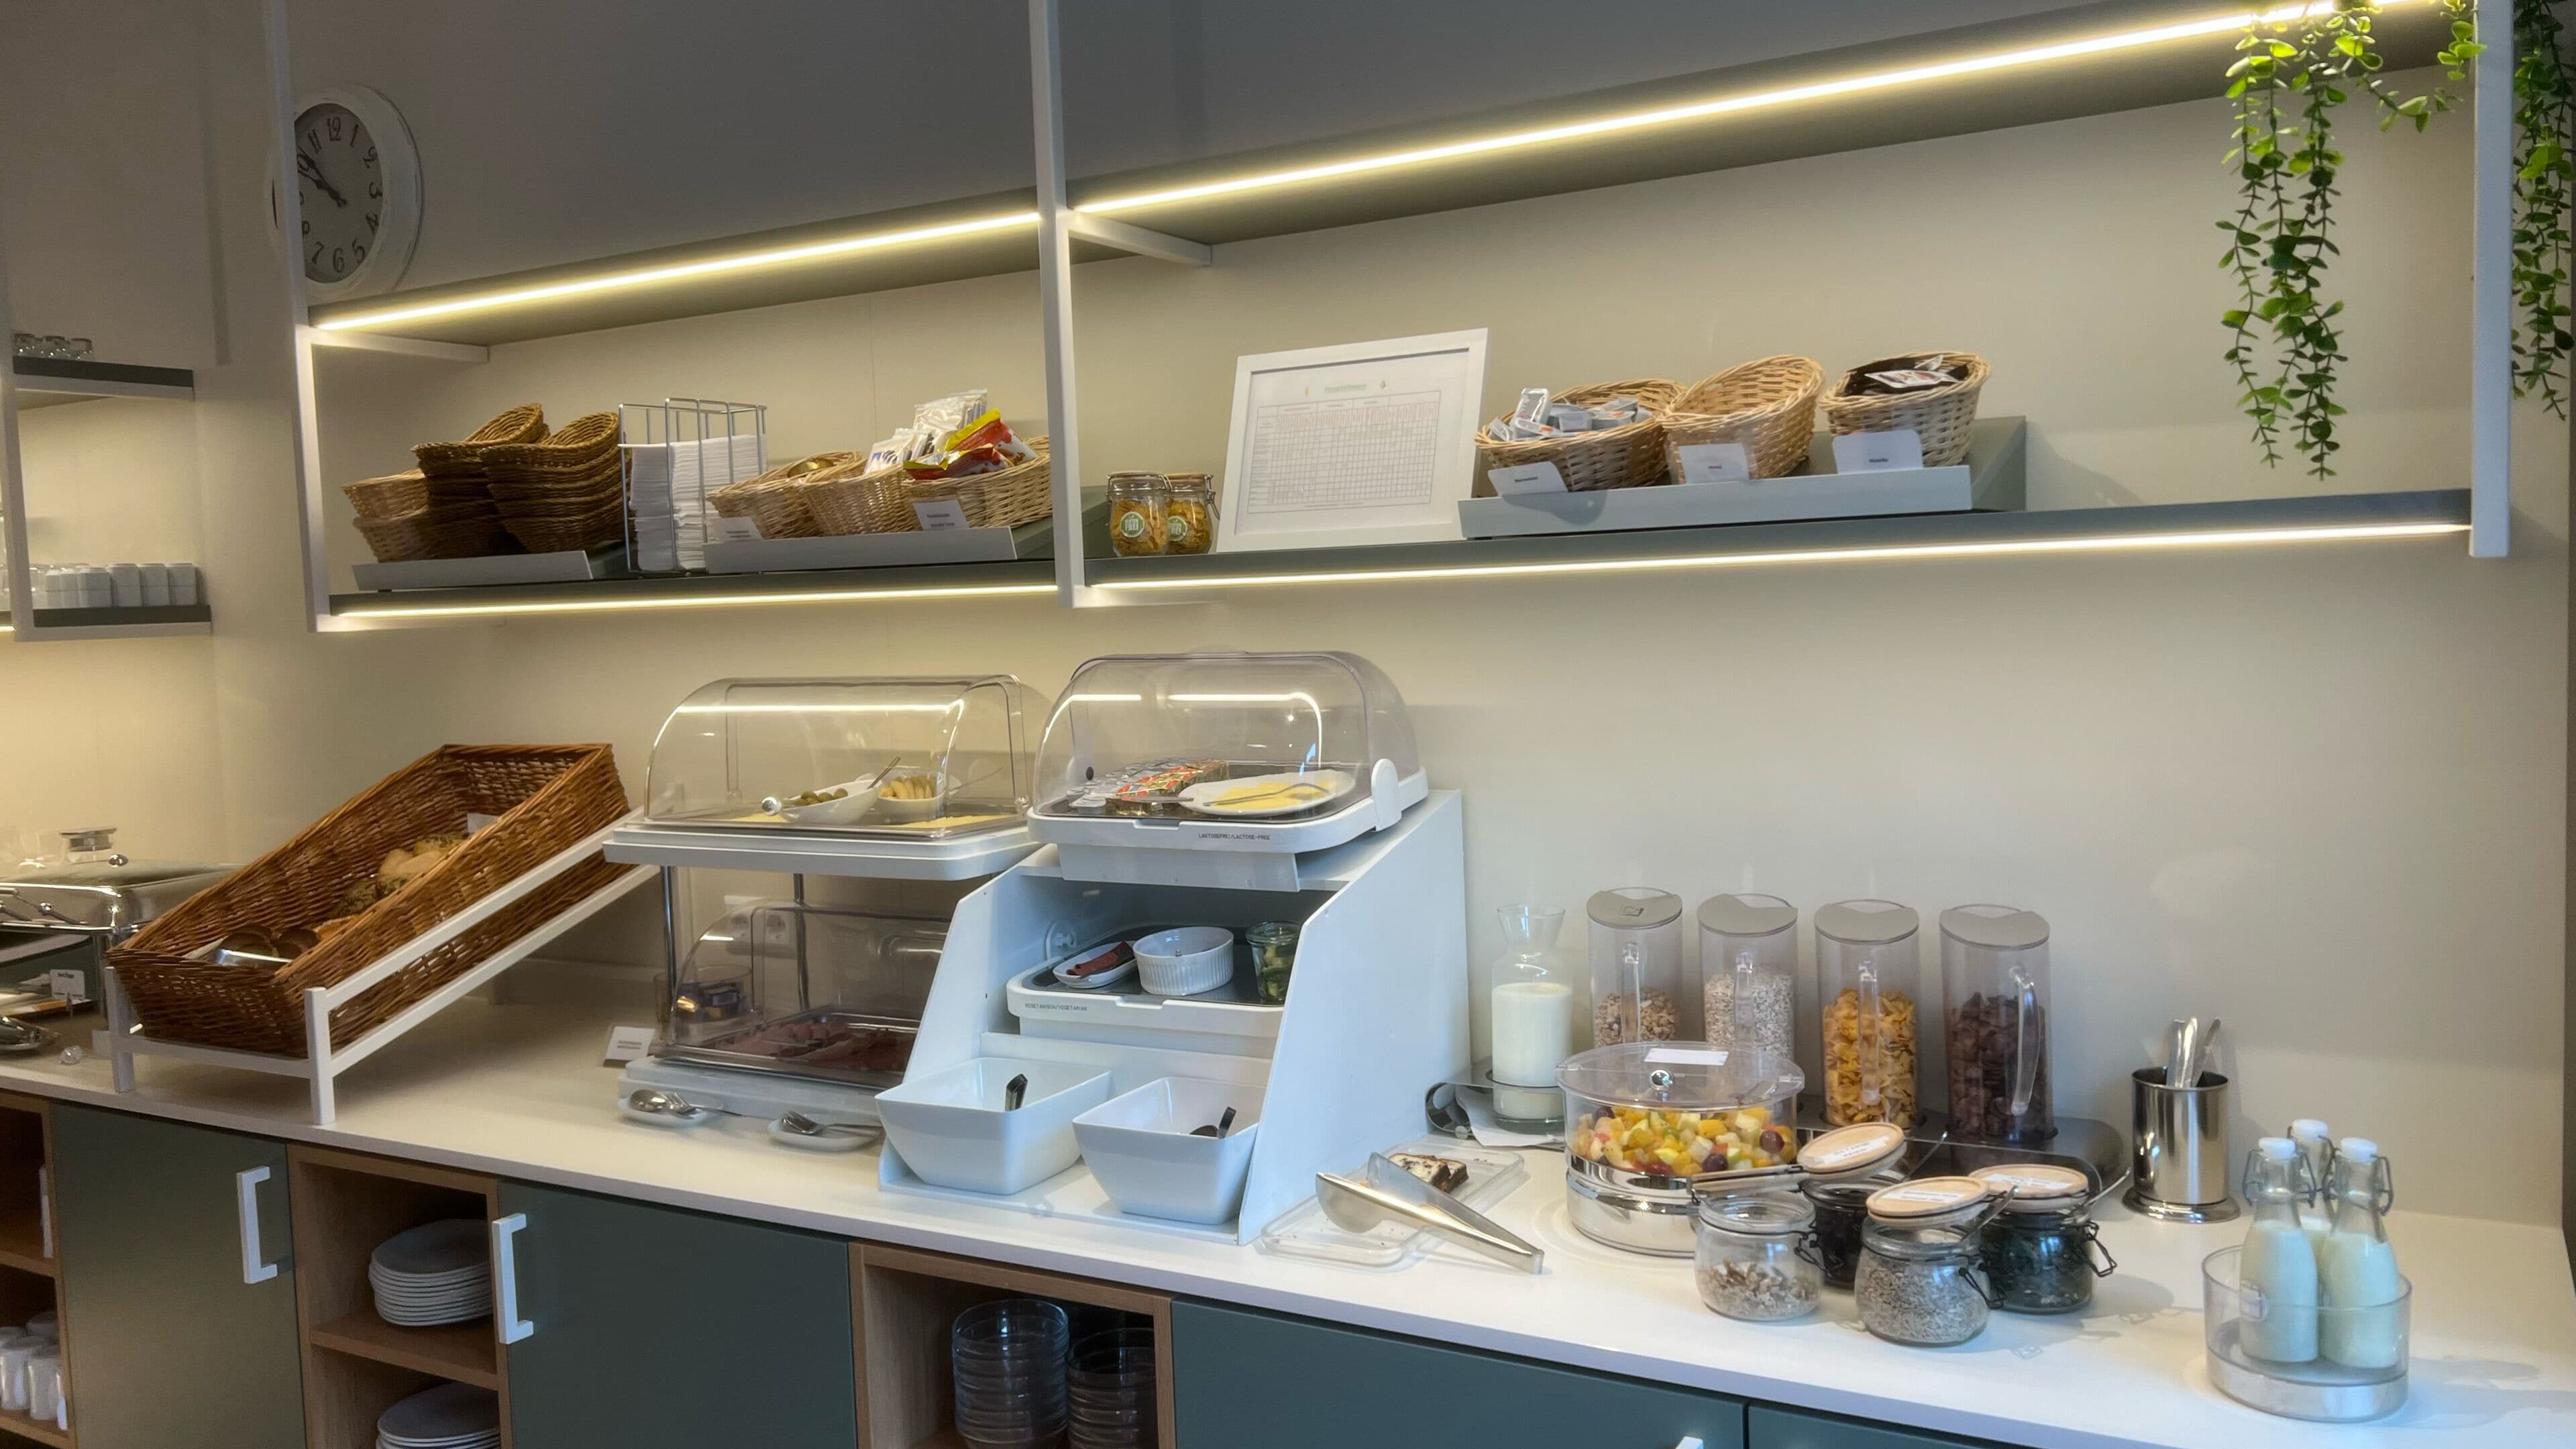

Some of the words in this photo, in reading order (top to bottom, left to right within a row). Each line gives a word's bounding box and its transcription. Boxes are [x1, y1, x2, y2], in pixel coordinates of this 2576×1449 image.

[327, 117, 341, 142] 12
[350, 124, 360, 148] 1
[362, 146, 378, 168] 2
[369, 182, 382, 199] 3
[311, 241, 325, 264] 7
[332, 248, 345, 273] 6
[352, 237, 365, 264] 5
[1197, 833, 1271, 841] LAKTOSEFREI/LACTOSE-FREE
